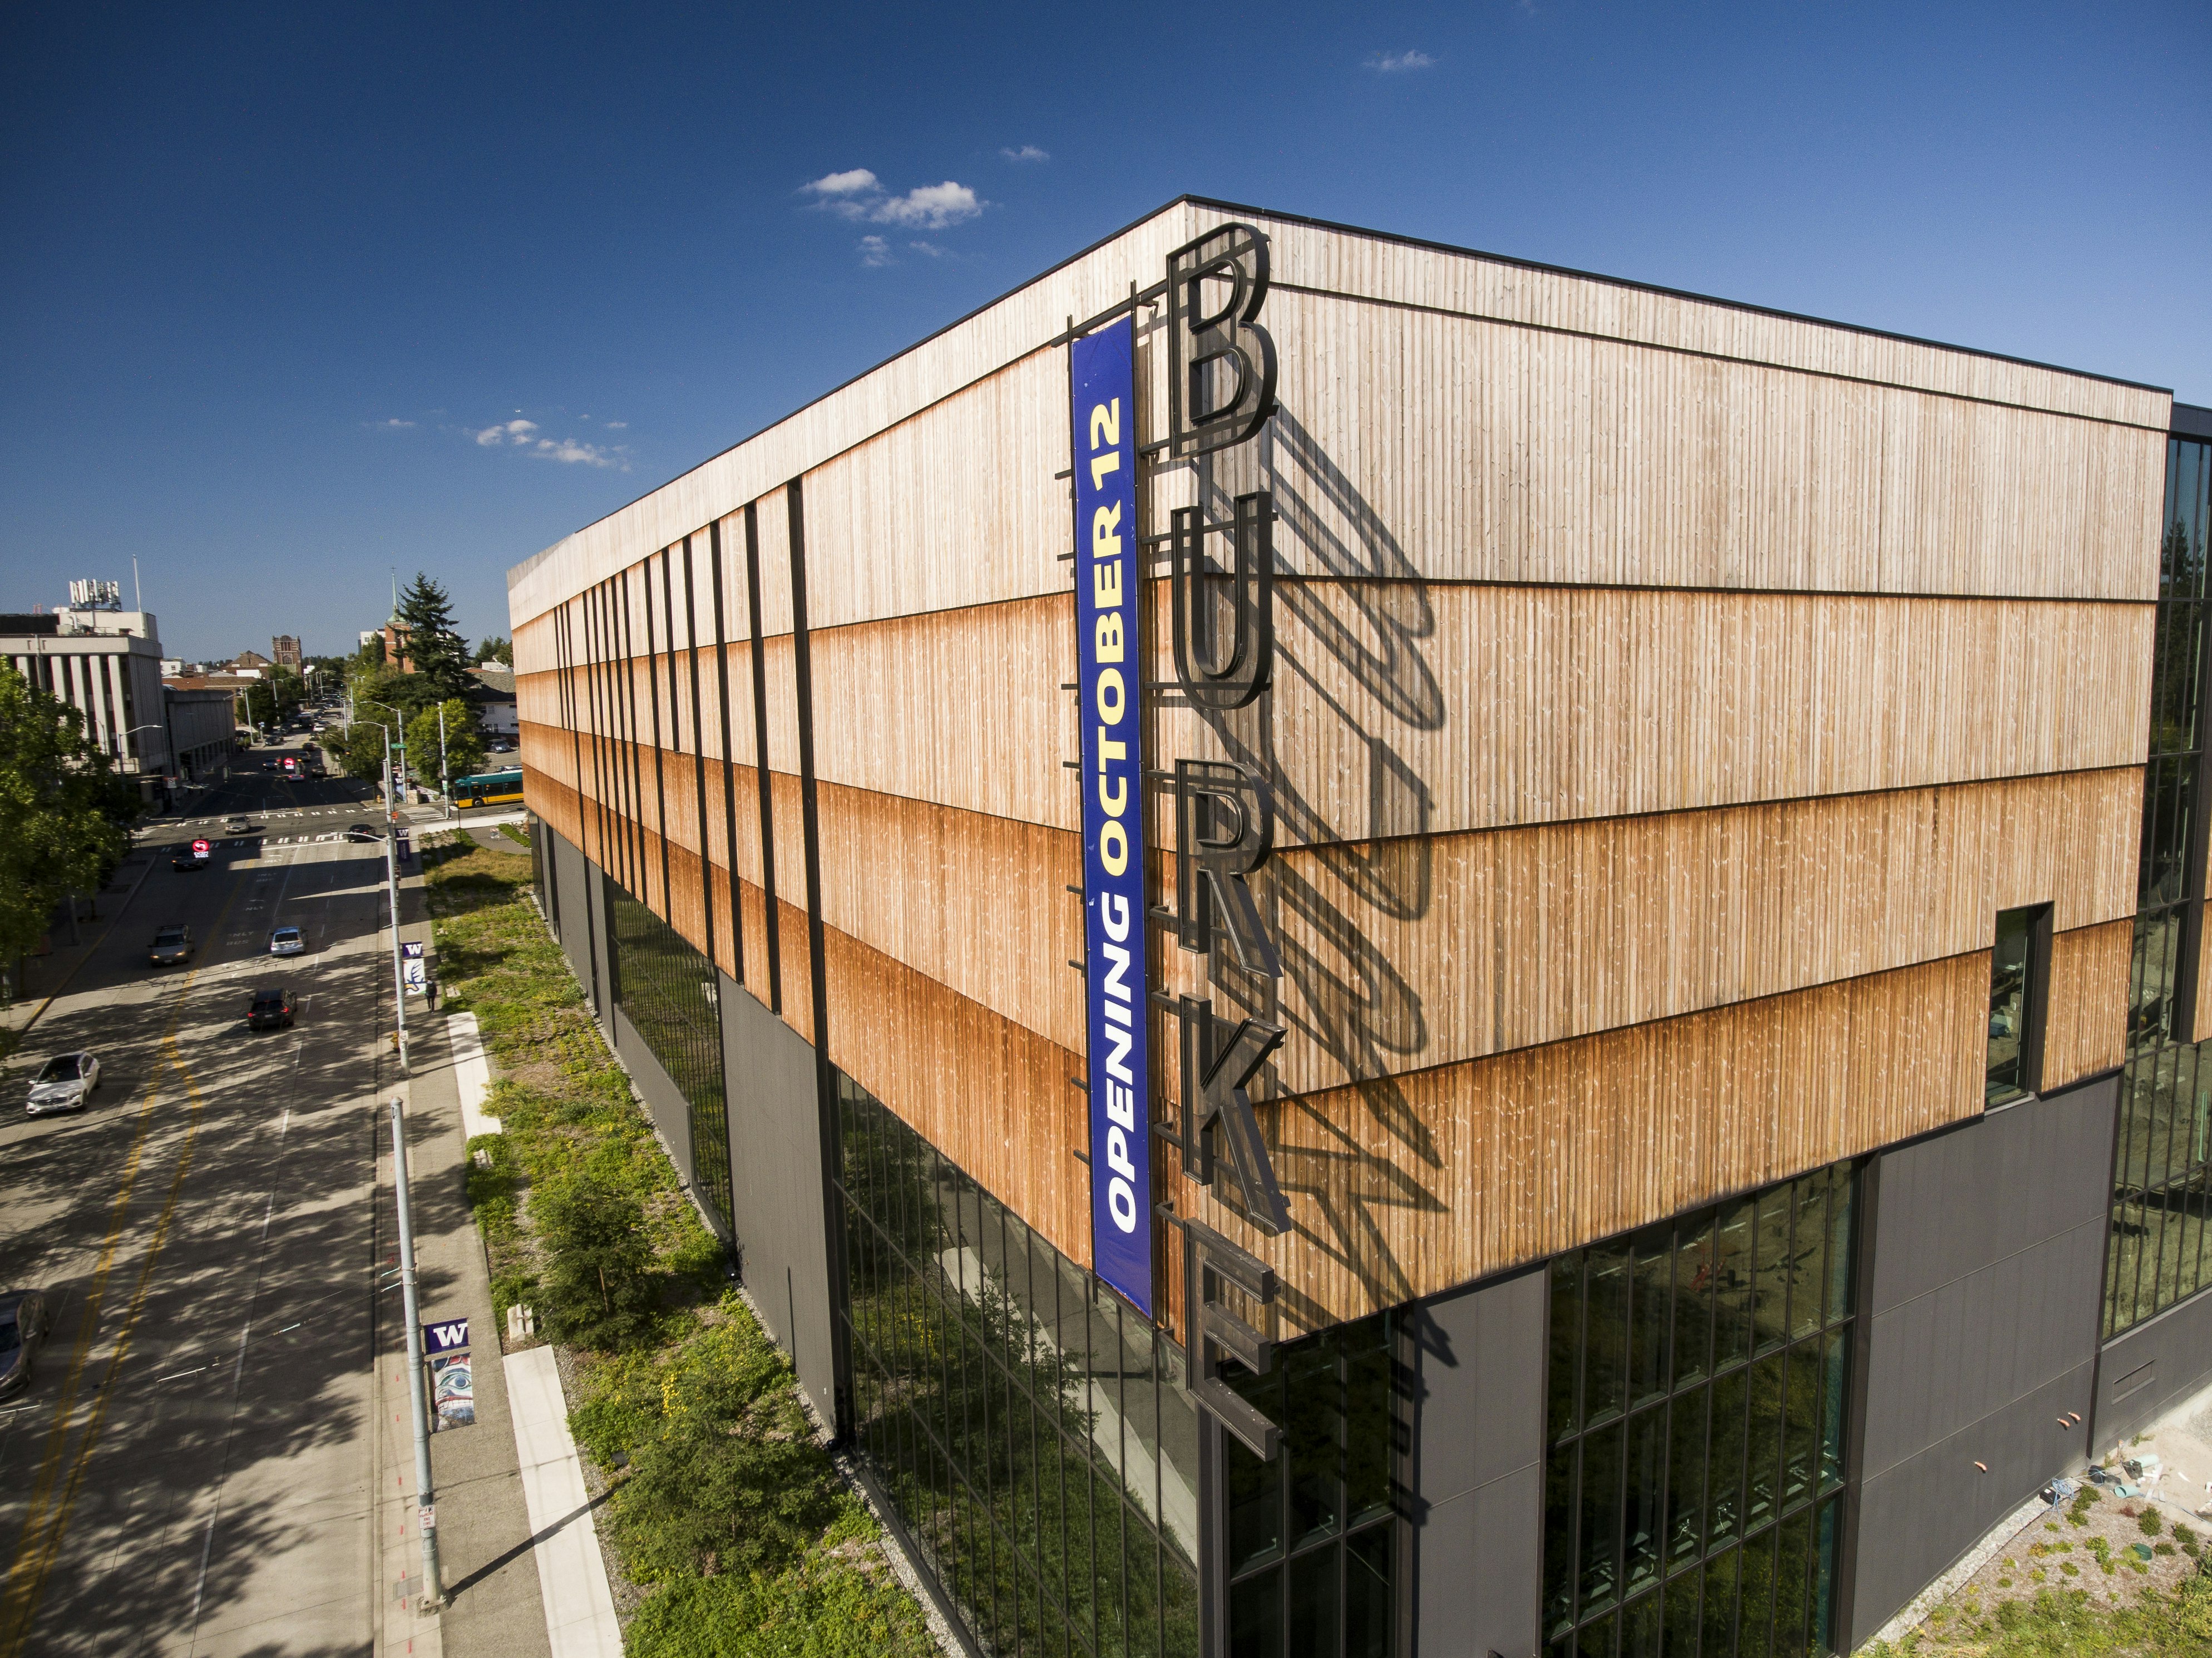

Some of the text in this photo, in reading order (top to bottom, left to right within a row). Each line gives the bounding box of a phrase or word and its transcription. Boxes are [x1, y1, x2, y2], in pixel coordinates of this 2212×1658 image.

[406, 943, 423, 955] W
[1090, 397, 1136, 1234] OPENING OCTOBER 12
[1166, 221, 1292, 1462] BURKE
[433, 1322, 468, 1348] W
